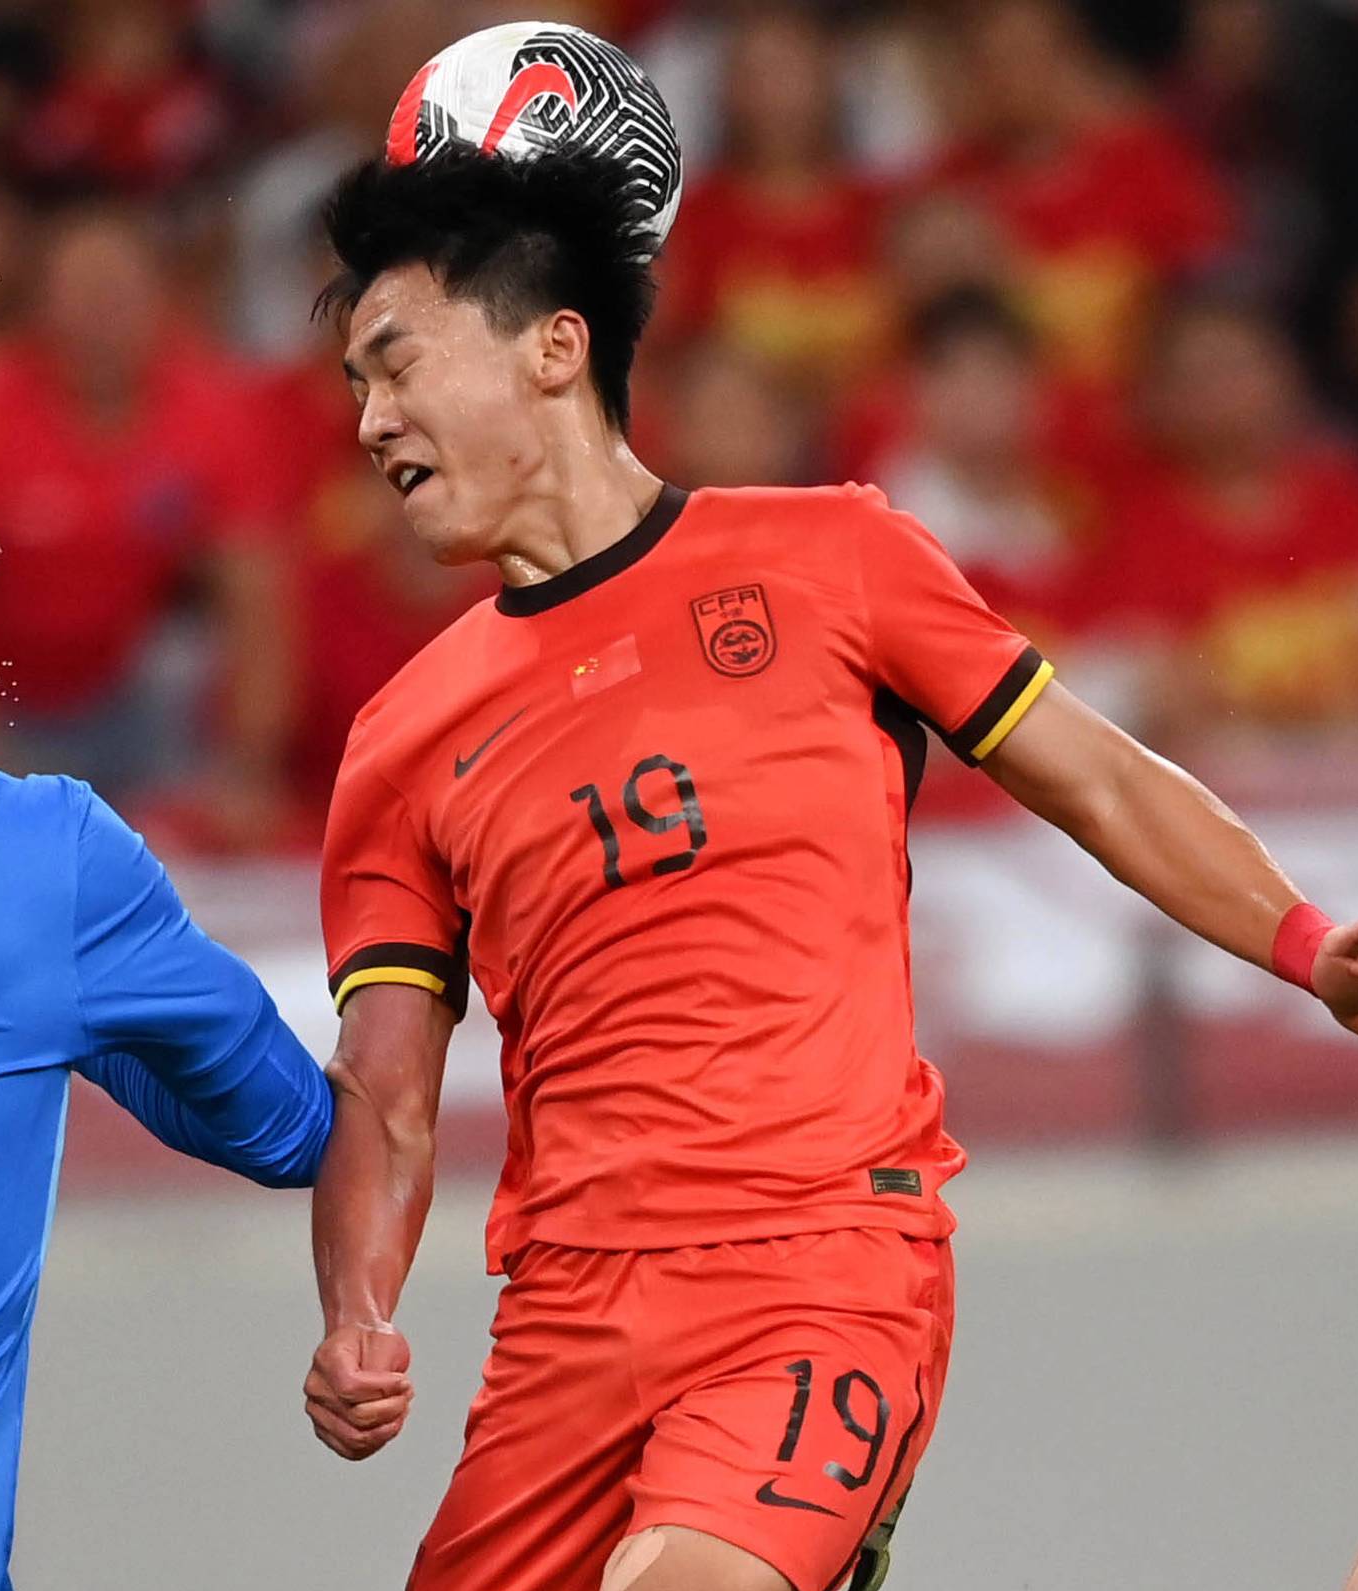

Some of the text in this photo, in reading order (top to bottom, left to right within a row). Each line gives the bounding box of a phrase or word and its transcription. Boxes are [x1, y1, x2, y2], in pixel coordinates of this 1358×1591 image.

[698, 590, 758, 616] CFA
[570, 754, 707, 888] 19
[777, 1359, 891, 1492] 19
